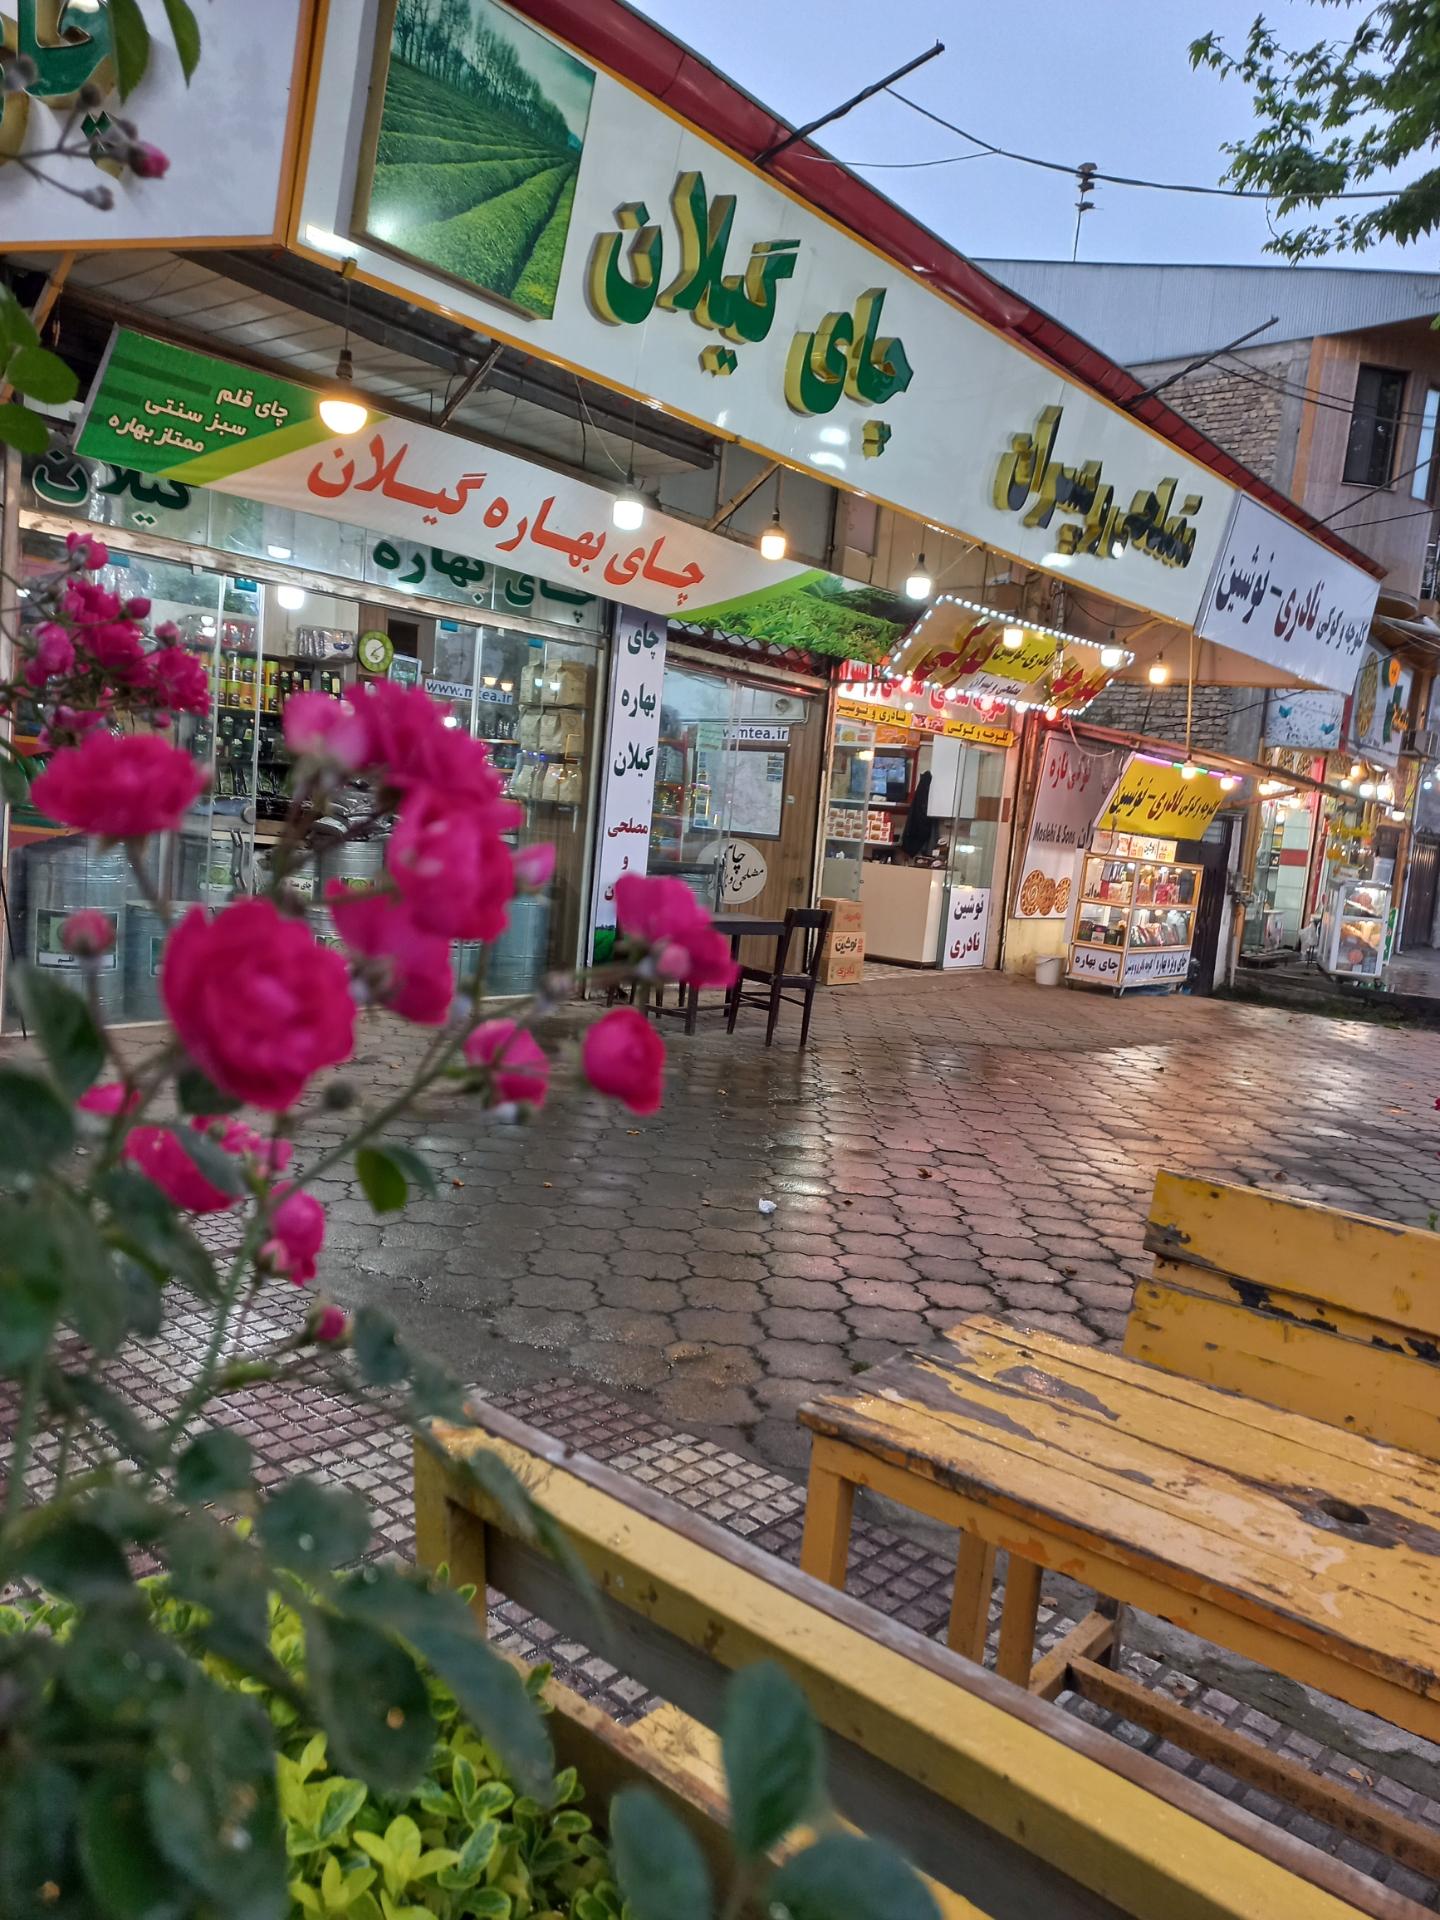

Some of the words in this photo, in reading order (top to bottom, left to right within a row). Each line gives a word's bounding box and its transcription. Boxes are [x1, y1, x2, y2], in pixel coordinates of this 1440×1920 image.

[583, 170, 801, 378] گیلان
[784, 287, 914, 459] چای
[216, 386, 254, 408] قلم
[144, 399, 203, 424] سنتی
[204, 412, 247, 437] سبز
[254, 402, 289, 428] چای
[108, 413, 155, 442] بهاره
[154, 426, 205, 453] ممتاز
[307, 433, 487, 525] گیلان
[483, 495, 607, 574] بهاره
[604, 536, 705, 607] چای
[627, 621, 660, 659] چای
[621, 683, 655, 718] بهاره
[614, 741, 654, 778] گیلان
[607, 817, 648, 837] مصلحی
[622, 855, 629, 870] و
[953, 893, 984, 920] نوشین
[834, 936, 858, 955] نوشین
[949, 932, 980, 959] نادری
[1075, 954, 1097, 970] بهاره
[1098, 955, 1119, 973] چای
